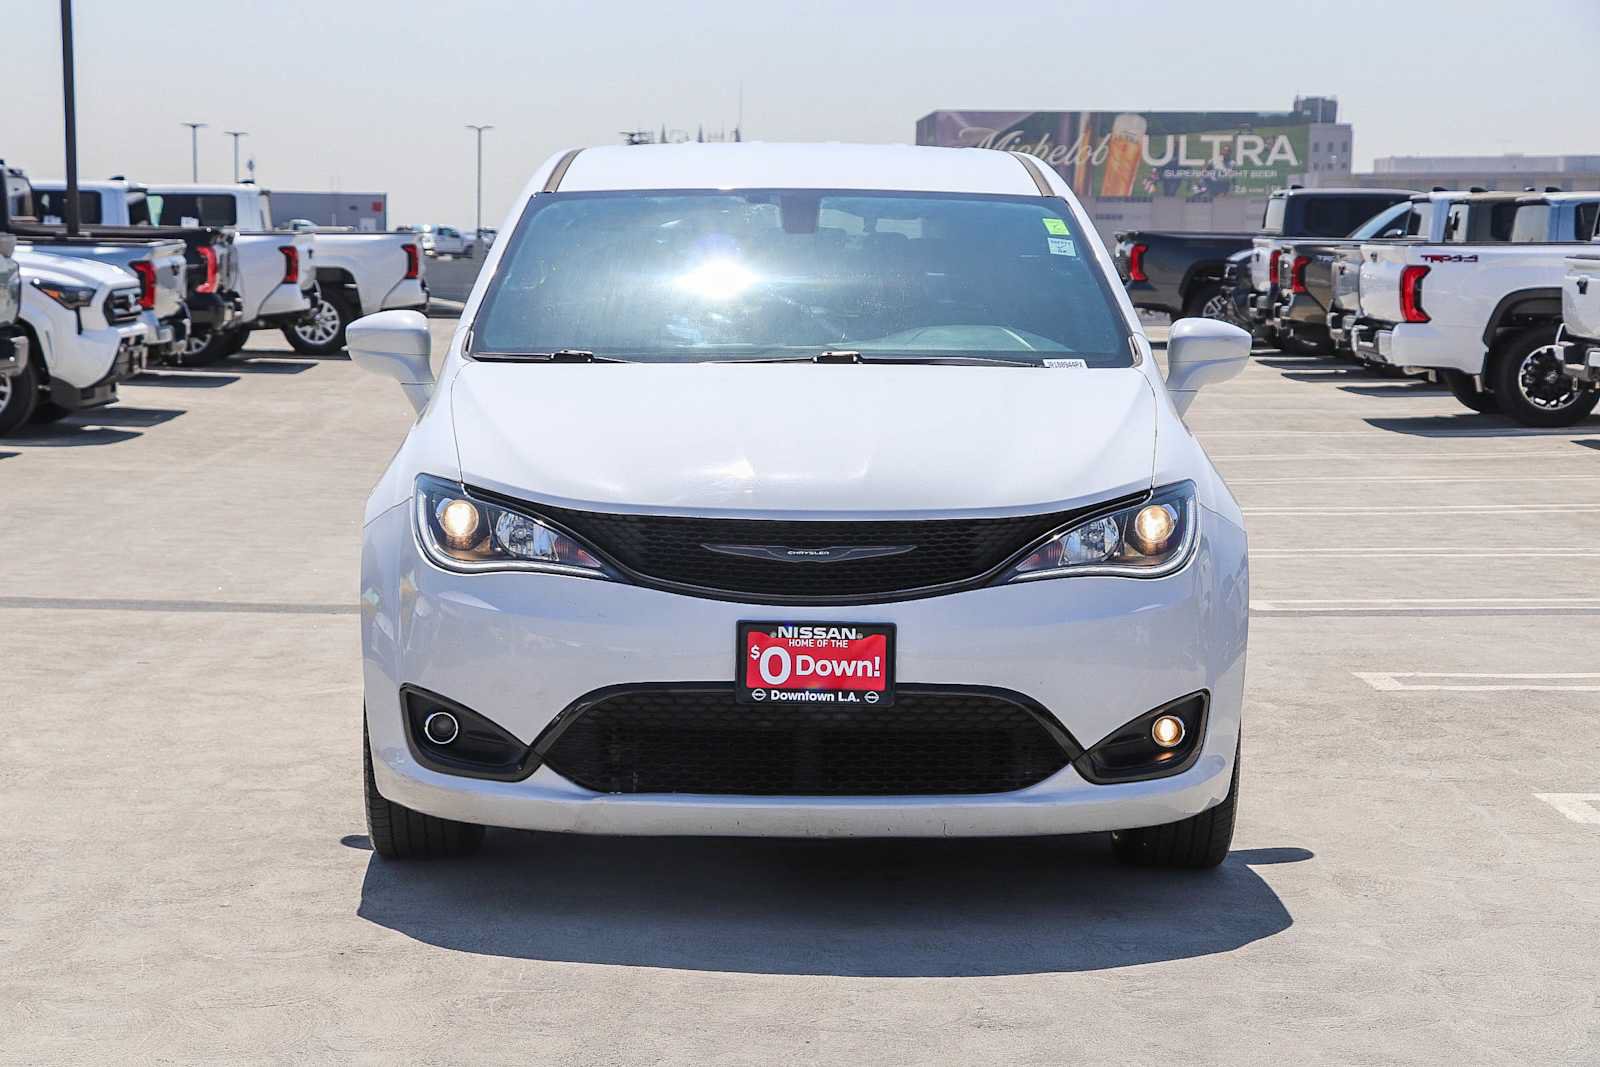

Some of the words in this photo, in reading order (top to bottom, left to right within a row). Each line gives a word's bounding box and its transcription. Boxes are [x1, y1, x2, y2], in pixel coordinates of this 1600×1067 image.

[960, 126, 1112, 166] Michelob
[1142, 134, 1299, 167] ULTRA
[1164, 169, 1215, 178] SUPERIOR
[1218, 169, 1249, 178] LIGHT
[777, 626, 856, 640] NISSAN
[788, 639, 814, 648] HOME
[817, 639, 829, 648] OF
[831, 639, 849, 649] THE
[796, 655, 881, 678] Down!
[770, 690, 835, 702] Downtown
[838, 691, 860, 702] L.A.
